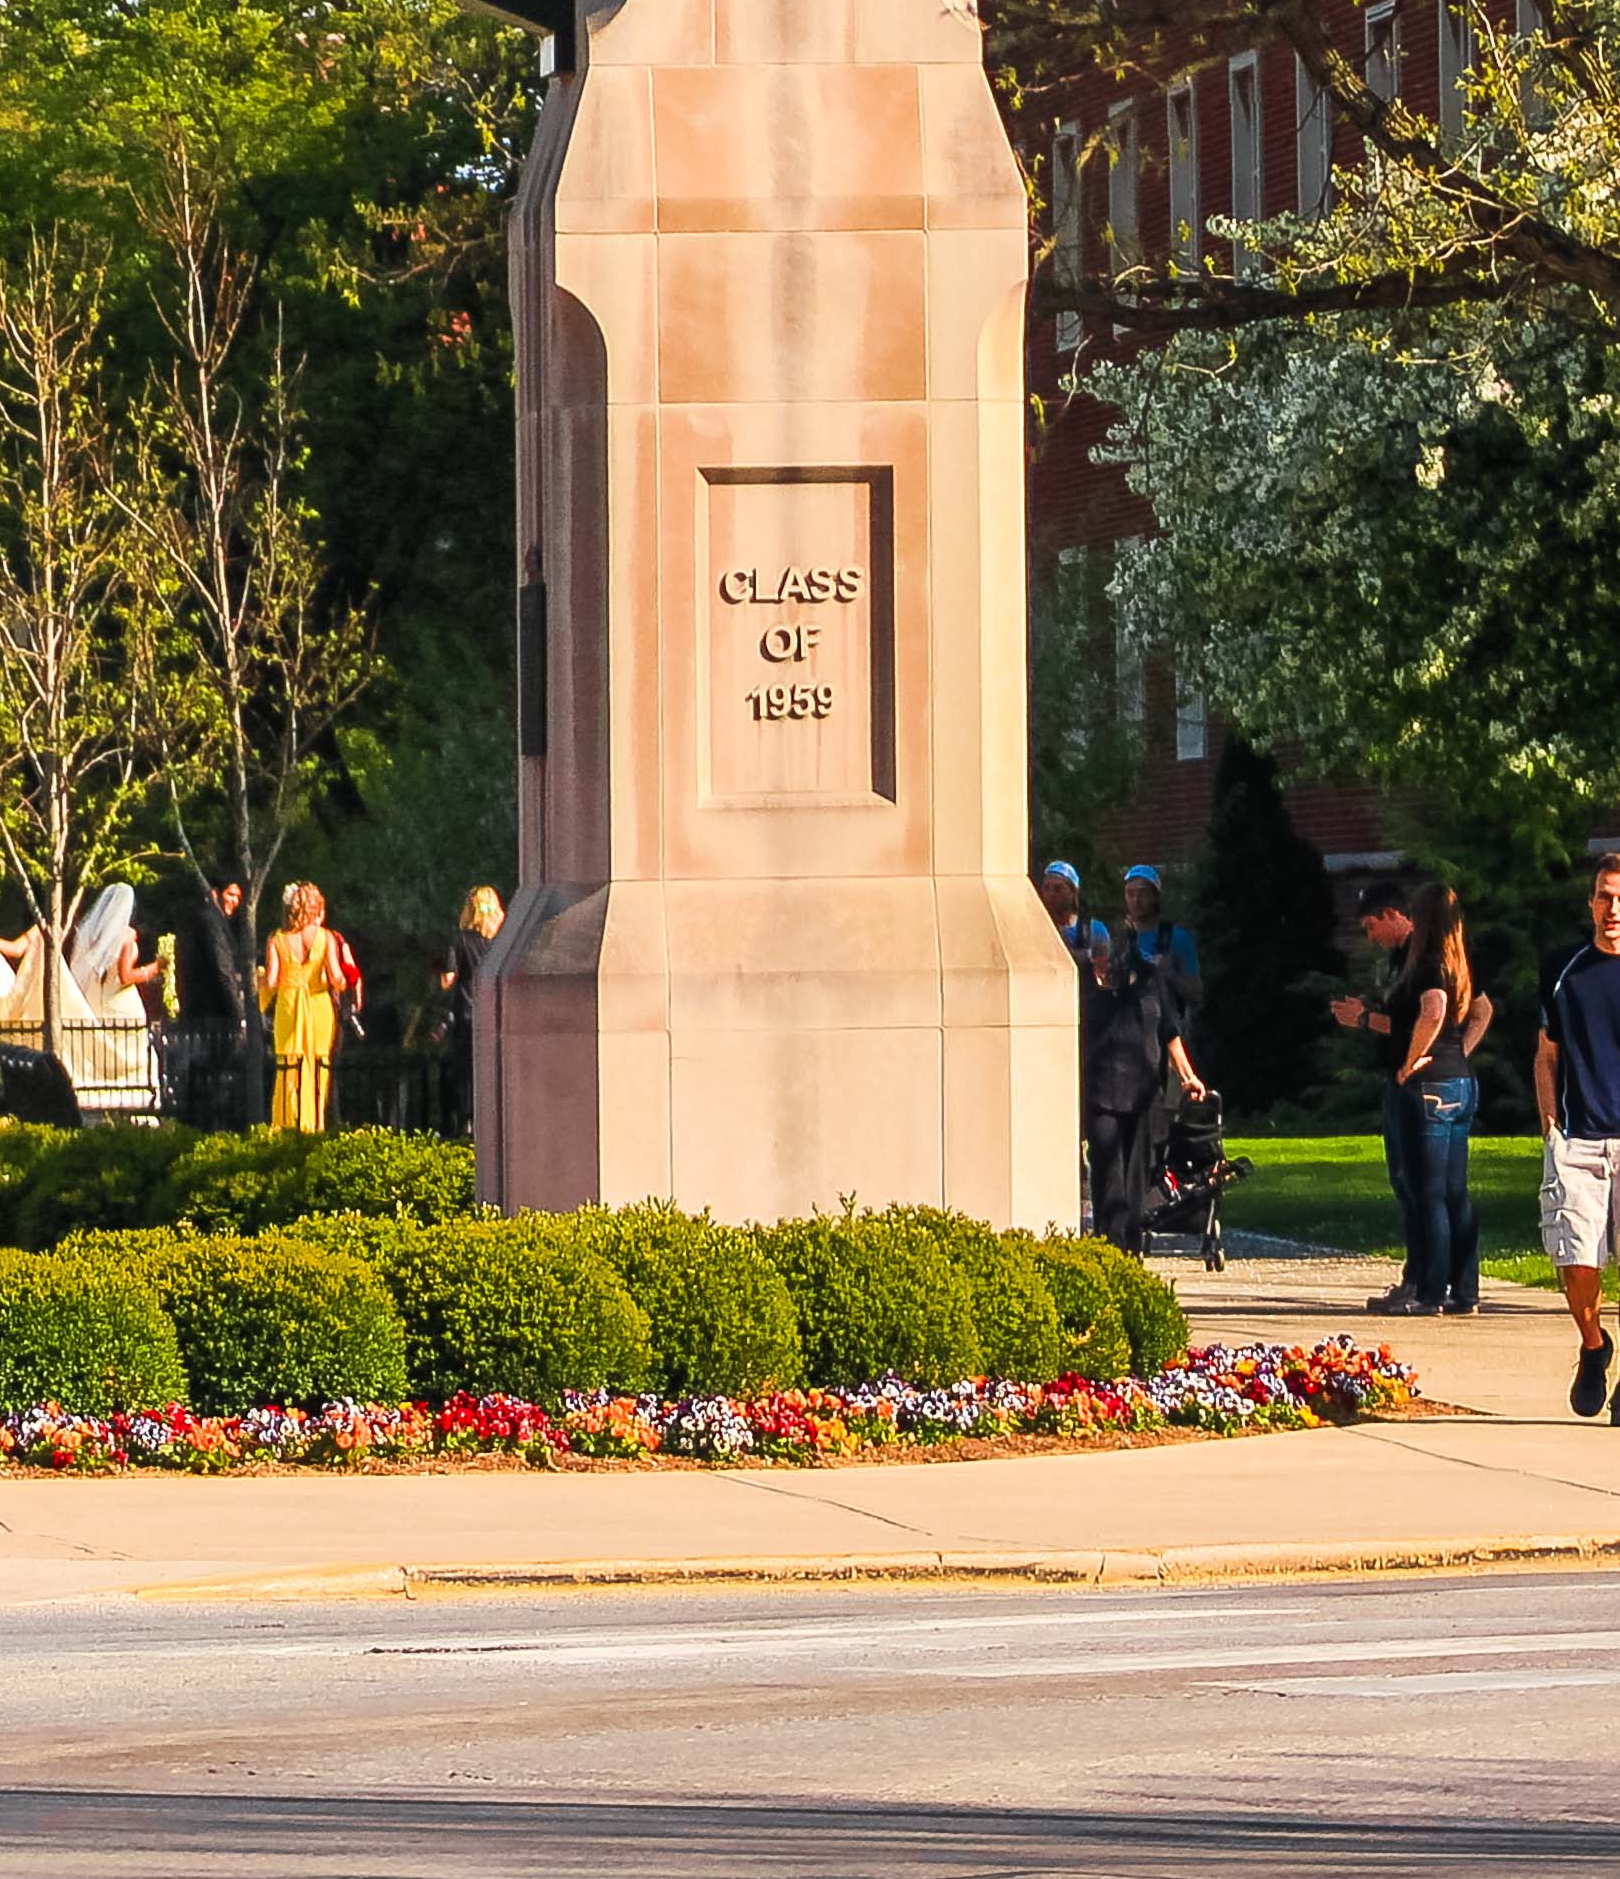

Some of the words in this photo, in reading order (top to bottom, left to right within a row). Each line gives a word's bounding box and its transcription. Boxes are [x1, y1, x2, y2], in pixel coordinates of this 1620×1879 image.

[718, 566, 865, 605] CLASS
[759, 623, 822, 663] OF
[744, 683, 835, 721] 1959
